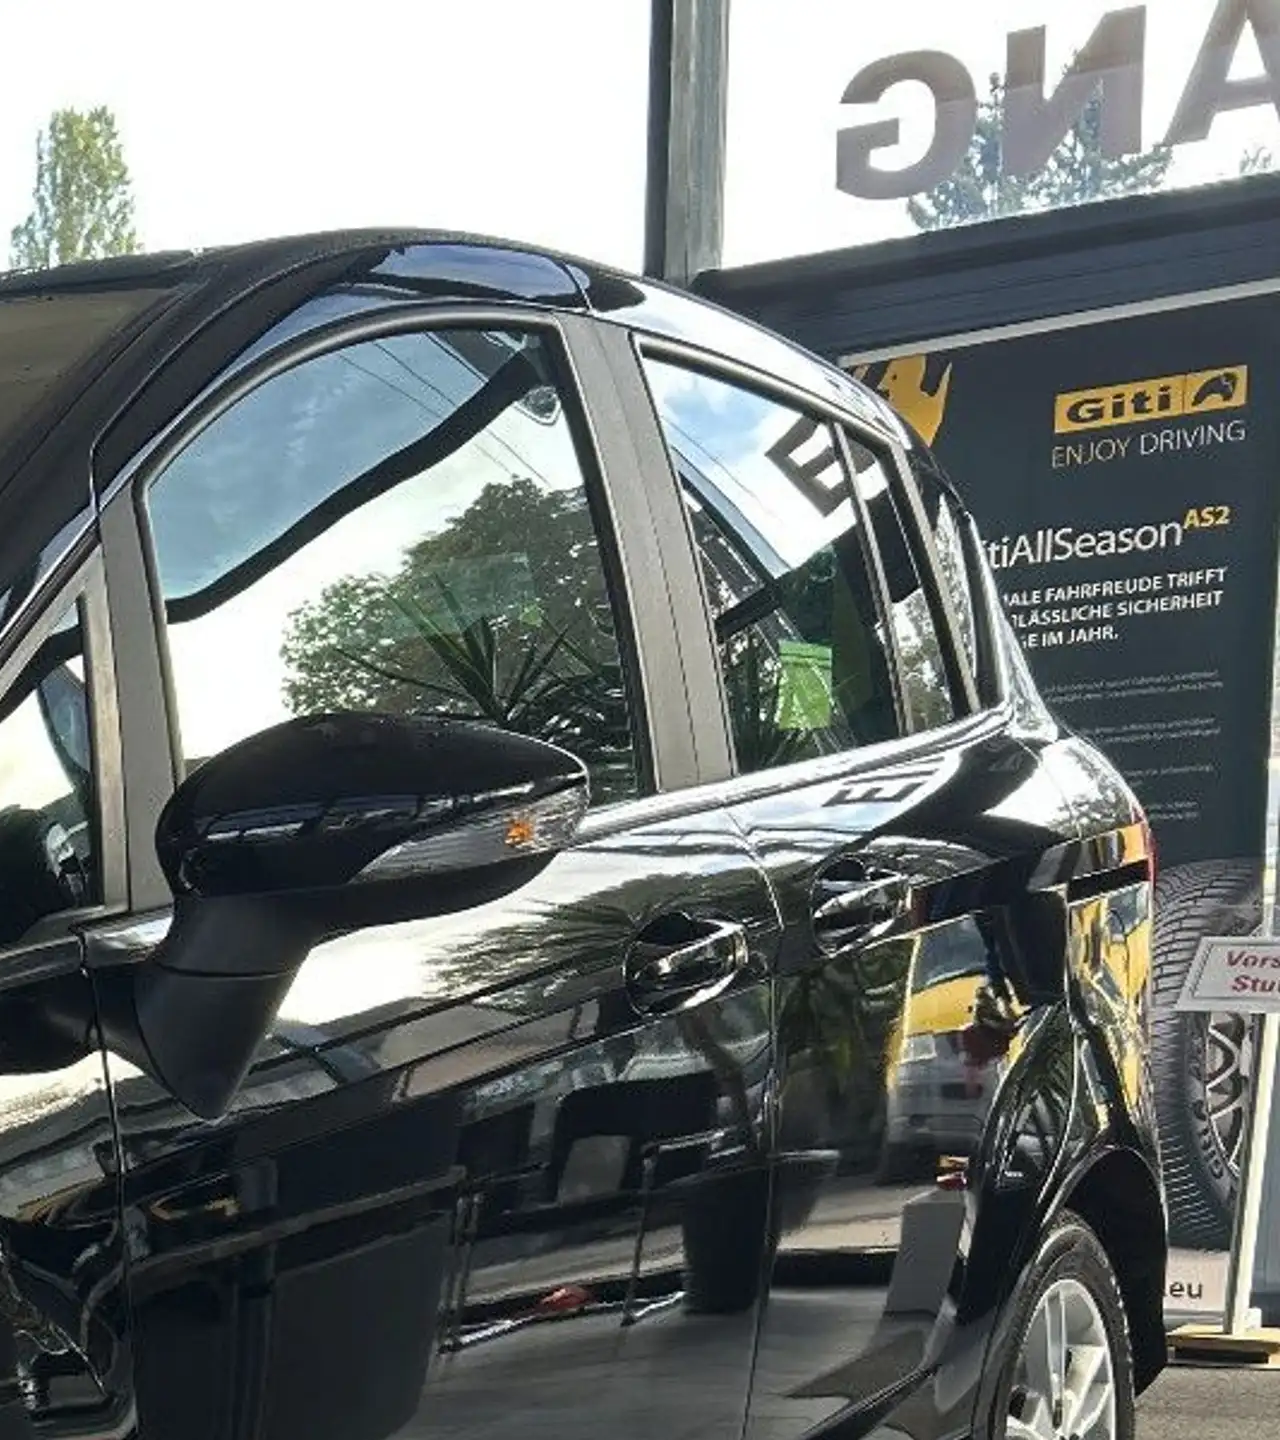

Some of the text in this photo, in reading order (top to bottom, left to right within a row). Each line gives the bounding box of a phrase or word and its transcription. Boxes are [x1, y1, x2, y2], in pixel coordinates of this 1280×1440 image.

[1066, 385, 1173, 425] Giti
[1051, 420, 1247, 469] ENJOY DRIVING
[1183, 505, 1231, 530] AS2
[1004, 567, 1228, 608] ALE FAHRFREUDE TRIFFT
[1117, 591, 1224, 617] SICHERHEIT
[1042, 630, 1063, 648] IM
[1067, 624, 1119, 646] JAHR.
